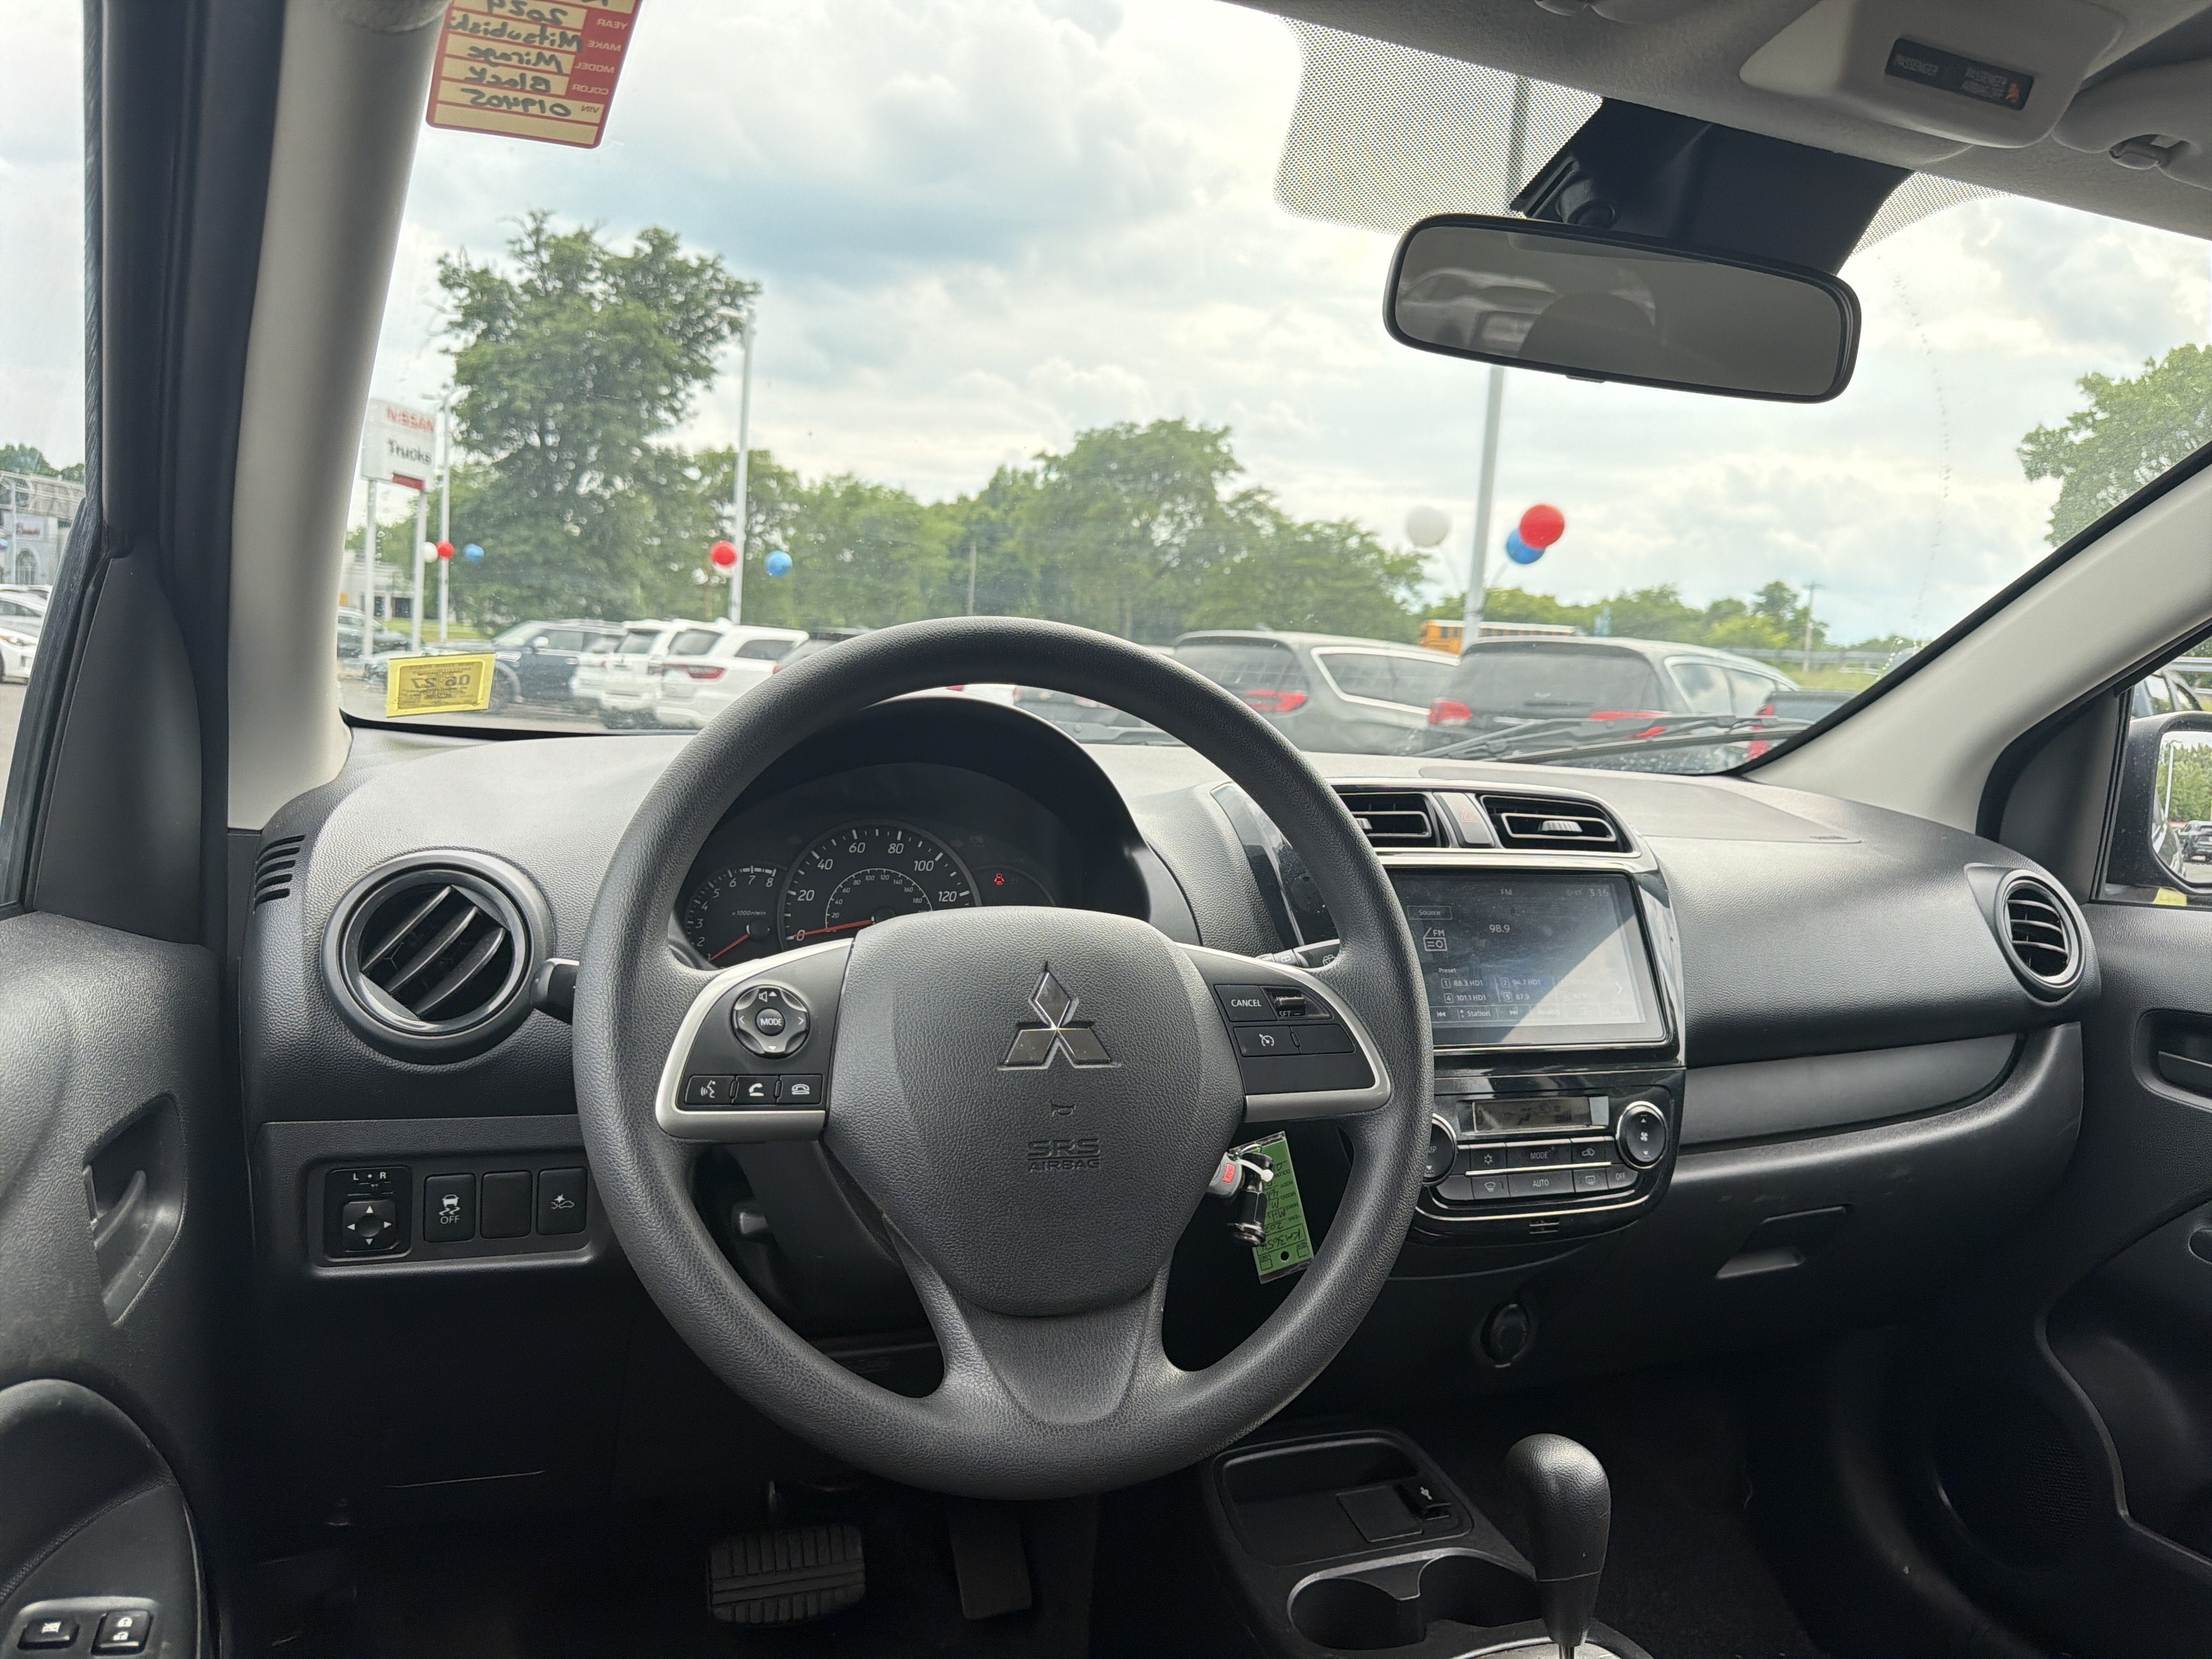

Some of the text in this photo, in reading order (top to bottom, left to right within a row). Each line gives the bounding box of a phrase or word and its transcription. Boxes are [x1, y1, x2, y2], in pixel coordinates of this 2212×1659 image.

[386, 405, 435, 432] NISSAN
[387, 438, 432, 464] Trucks
[849, 843, 866, 853] 60
[888, 843, 904, 854] 80
[817, 859, 833, 870] 40
[913, 860, 934, 871] 100
[729, 878, 737, 888] 6
[748, 875, 756, 885] 7
[766, 878, 774, 887] 8
[713, 888, 721, 899] 5
[797, 889, 815, 901] 20
[938, 891, 957, 902] 120
[701, 901, 708, 911] 4
[695, 918, 703, 928] 3
[1489, 924, 1510, 933] 98.9
[796, 929, 806, 941] 0
[697, 937, 705, 947] 2
[1231, 998, 1262, 1007] CANCEL
[760, 1017, 783, 1026] MODE
[1027, 1138, 1101, 1157] SRS
[1530, 1151, 1549, 1160] MODE
[1027, 1159, 1101, 1171] AIRBAG
[353, 1173, 359, 1181] L
[1615, 1172, 1627, 1181] OFF
[1532, 1178, 1550, 1188] AUTO
[440, 1215, 460, 1224] OFF
